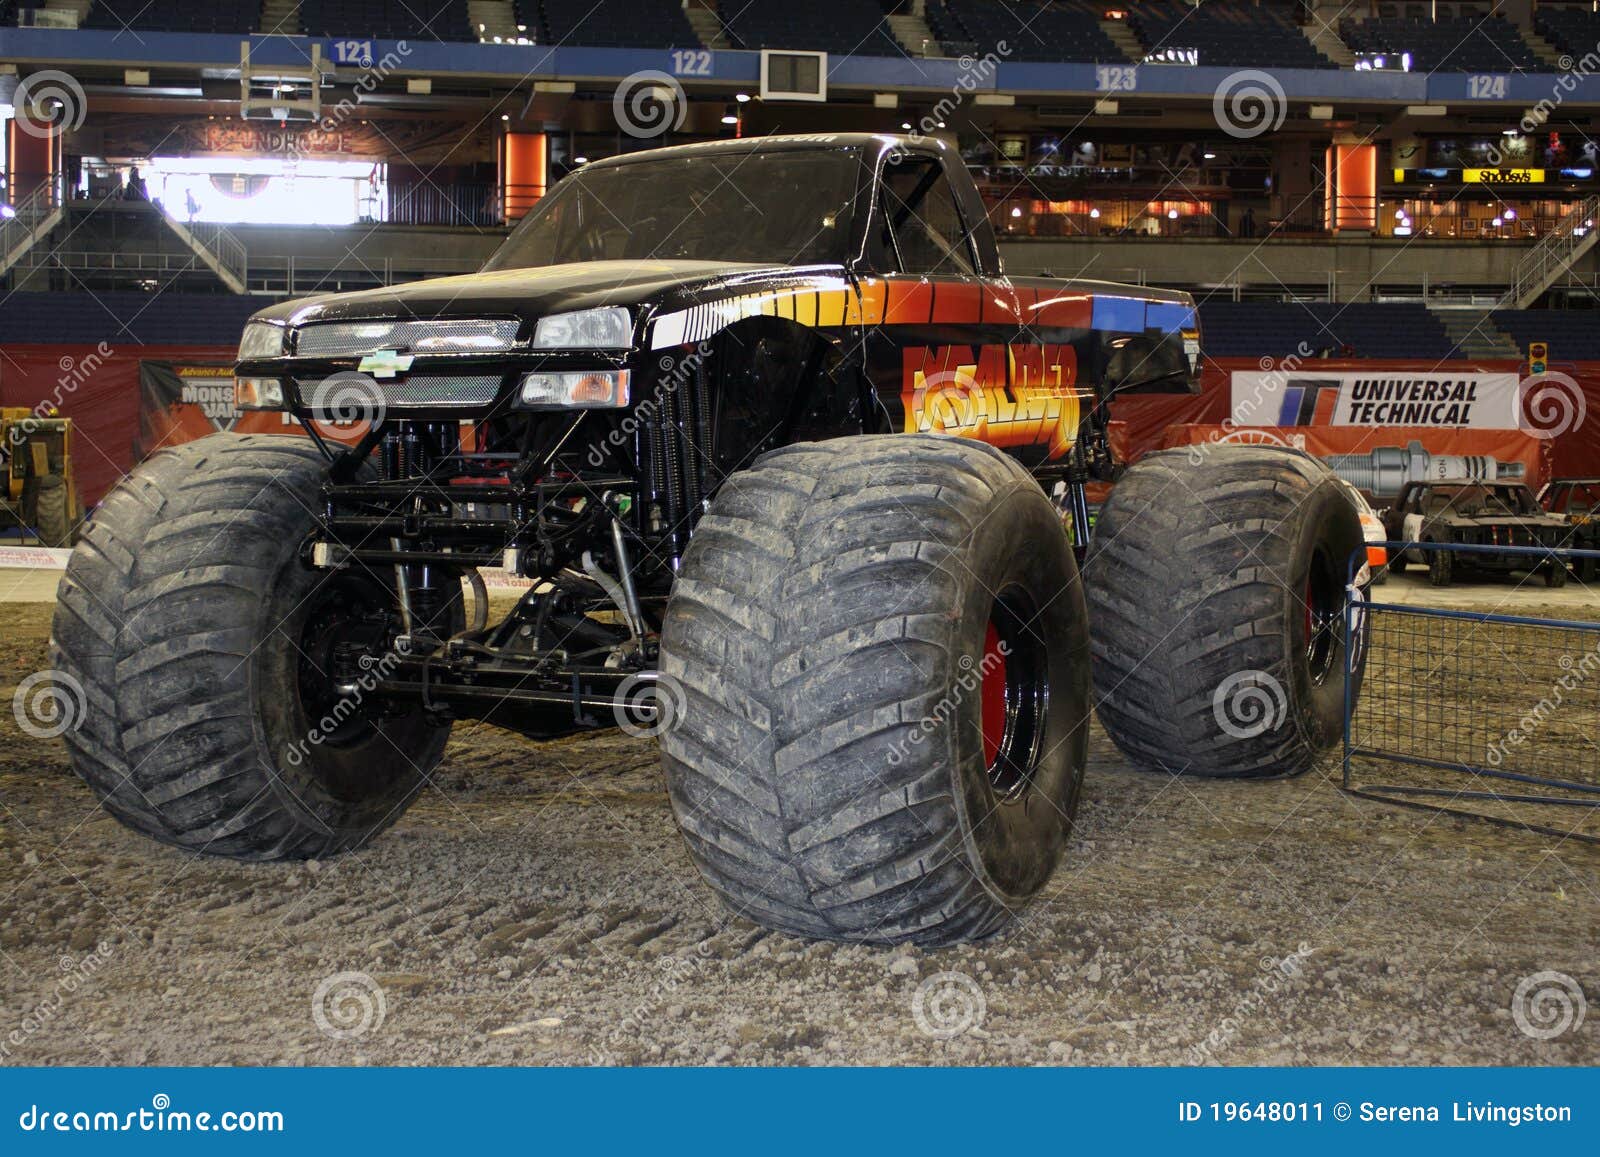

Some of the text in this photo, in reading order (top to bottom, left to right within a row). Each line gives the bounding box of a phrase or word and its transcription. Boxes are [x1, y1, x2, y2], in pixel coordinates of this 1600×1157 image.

[334, 40, 371, 63] 121
[671, 49, 711, 75] 122
[1098, 67, 1136, 91] 123
[1467, 74, 1505, 100] 124
[217, 367, 236, 377] Aut
[1351, 379, 1477, 402] UNIVERSAL
[1348, 403, 1471, 425] TECHNICAL
